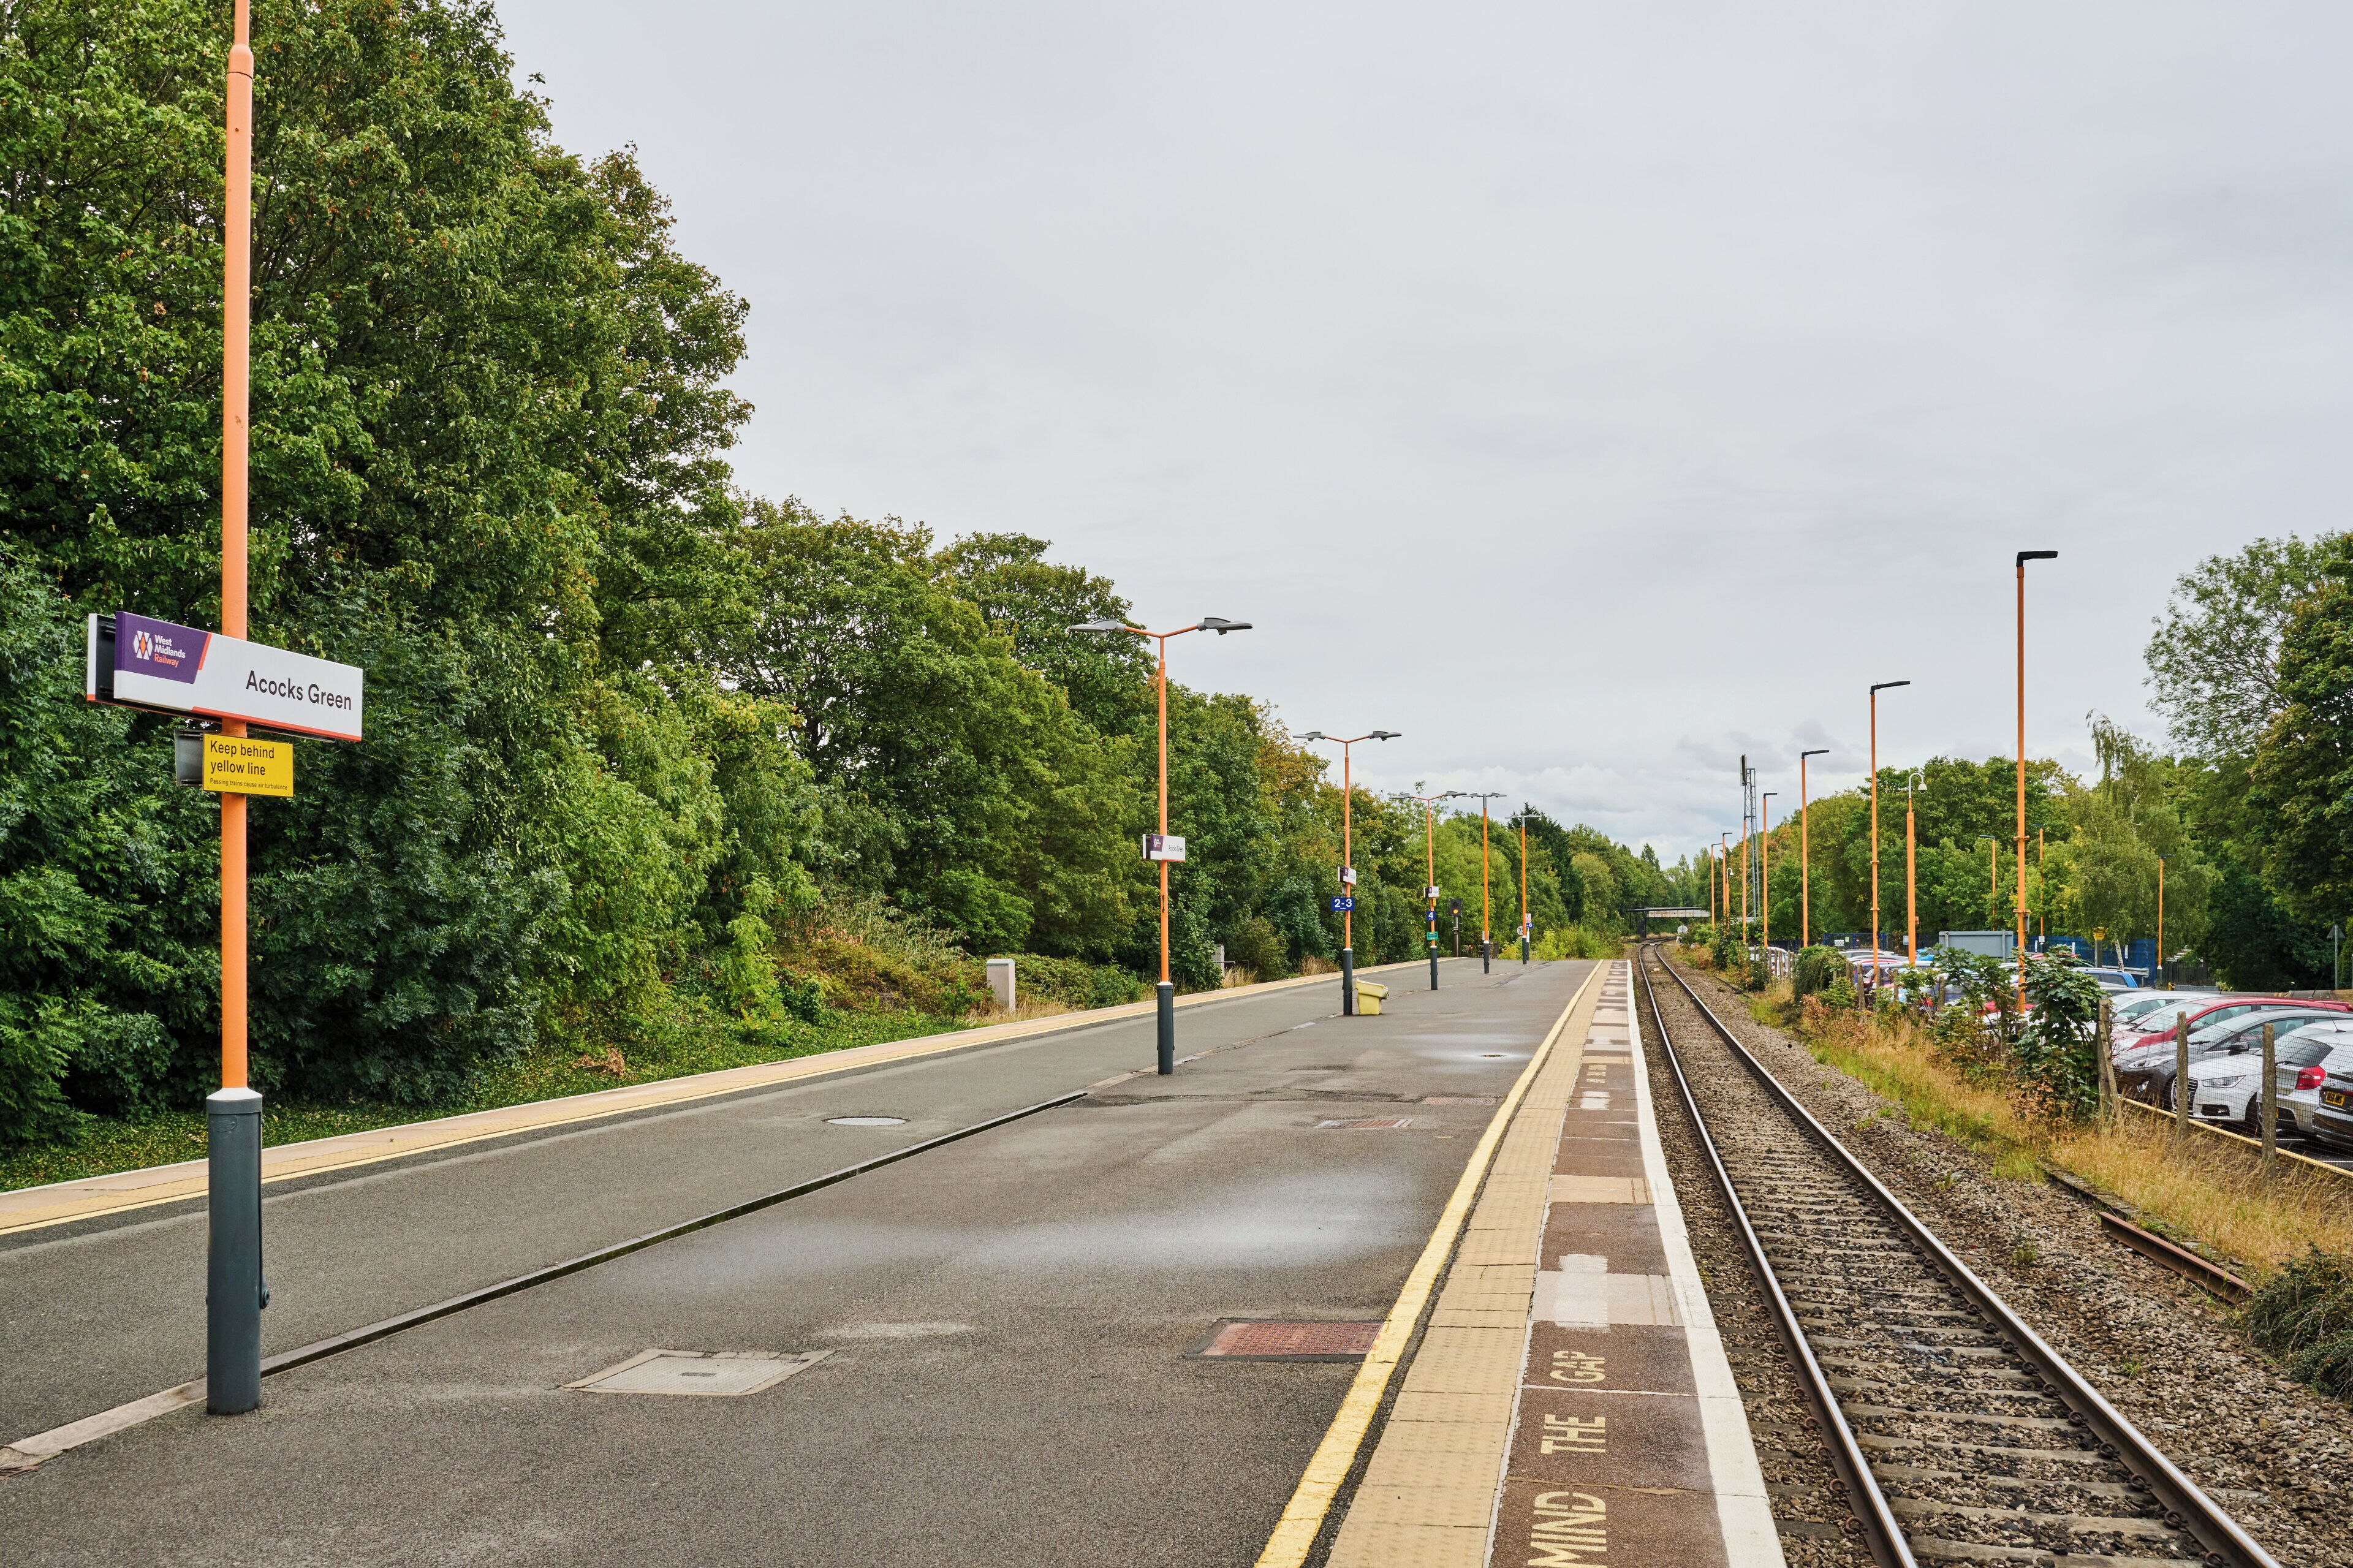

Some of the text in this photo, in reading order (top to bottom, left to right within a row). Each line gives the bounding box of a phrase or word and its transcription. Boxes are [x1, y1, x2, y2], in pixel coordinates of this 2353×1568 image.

[154, 635, 172, 646] West
[154, 645, 186, 659] Midlands
[154, 654, 179, 668] Railway
[246, 670, 351, 710] Acocks Green
[210, 740, 274, 759] Keep behind
[210, 760, 265, 775] yellow line
[1528, 1350, 1607, 1568] MIND THE GAP
